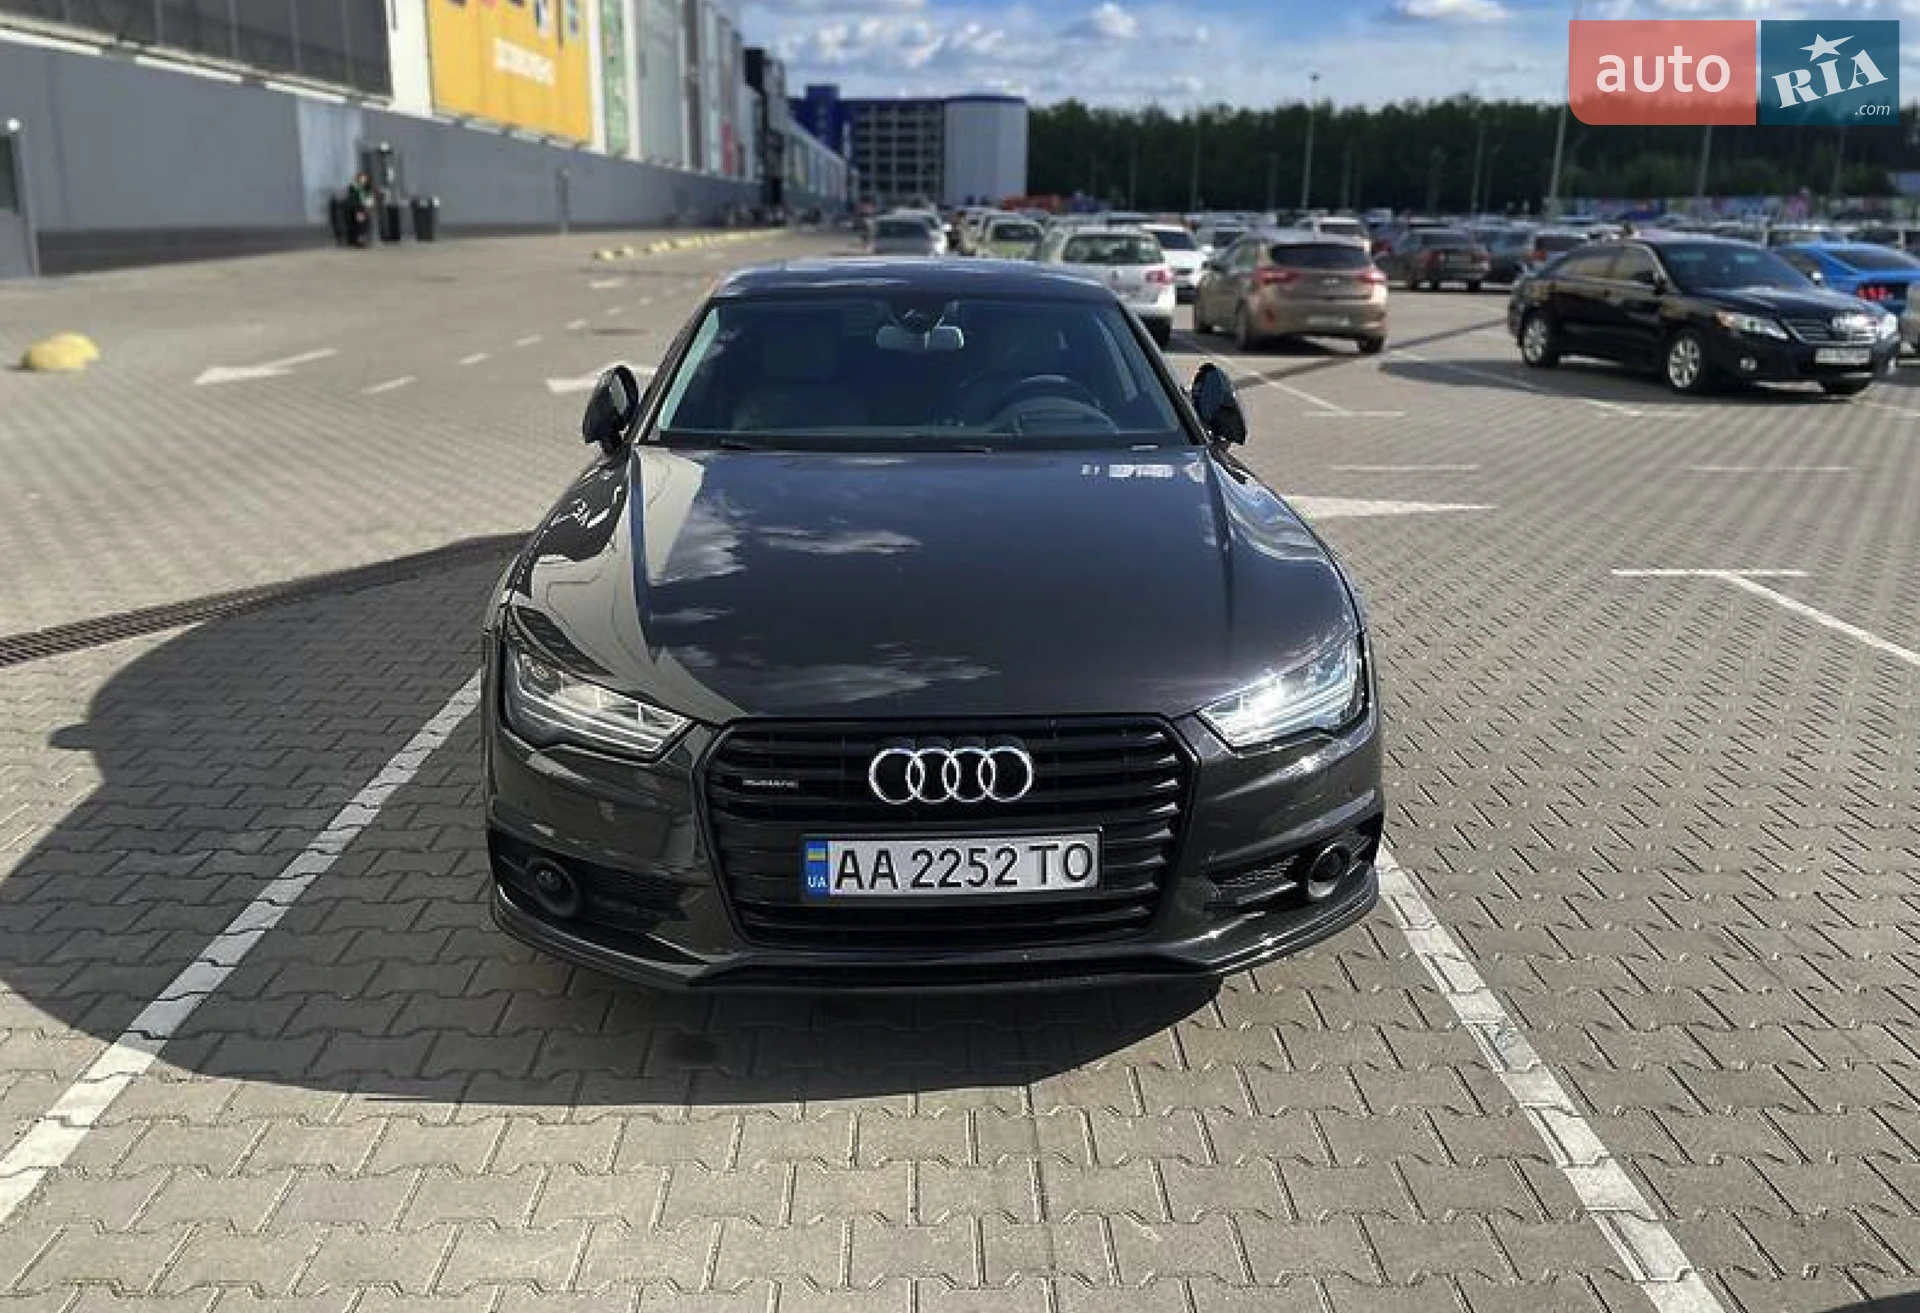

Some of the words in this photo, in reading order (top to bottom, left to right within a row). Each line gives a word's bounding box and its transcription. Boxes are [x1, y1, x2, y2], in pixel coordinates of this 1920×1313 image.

[807, 874, 828, 888] UA
[835, 848, 899, 890] AA
[910, 847, 1018, 888] 2252
[1028, 843, 1093, 886] TO
